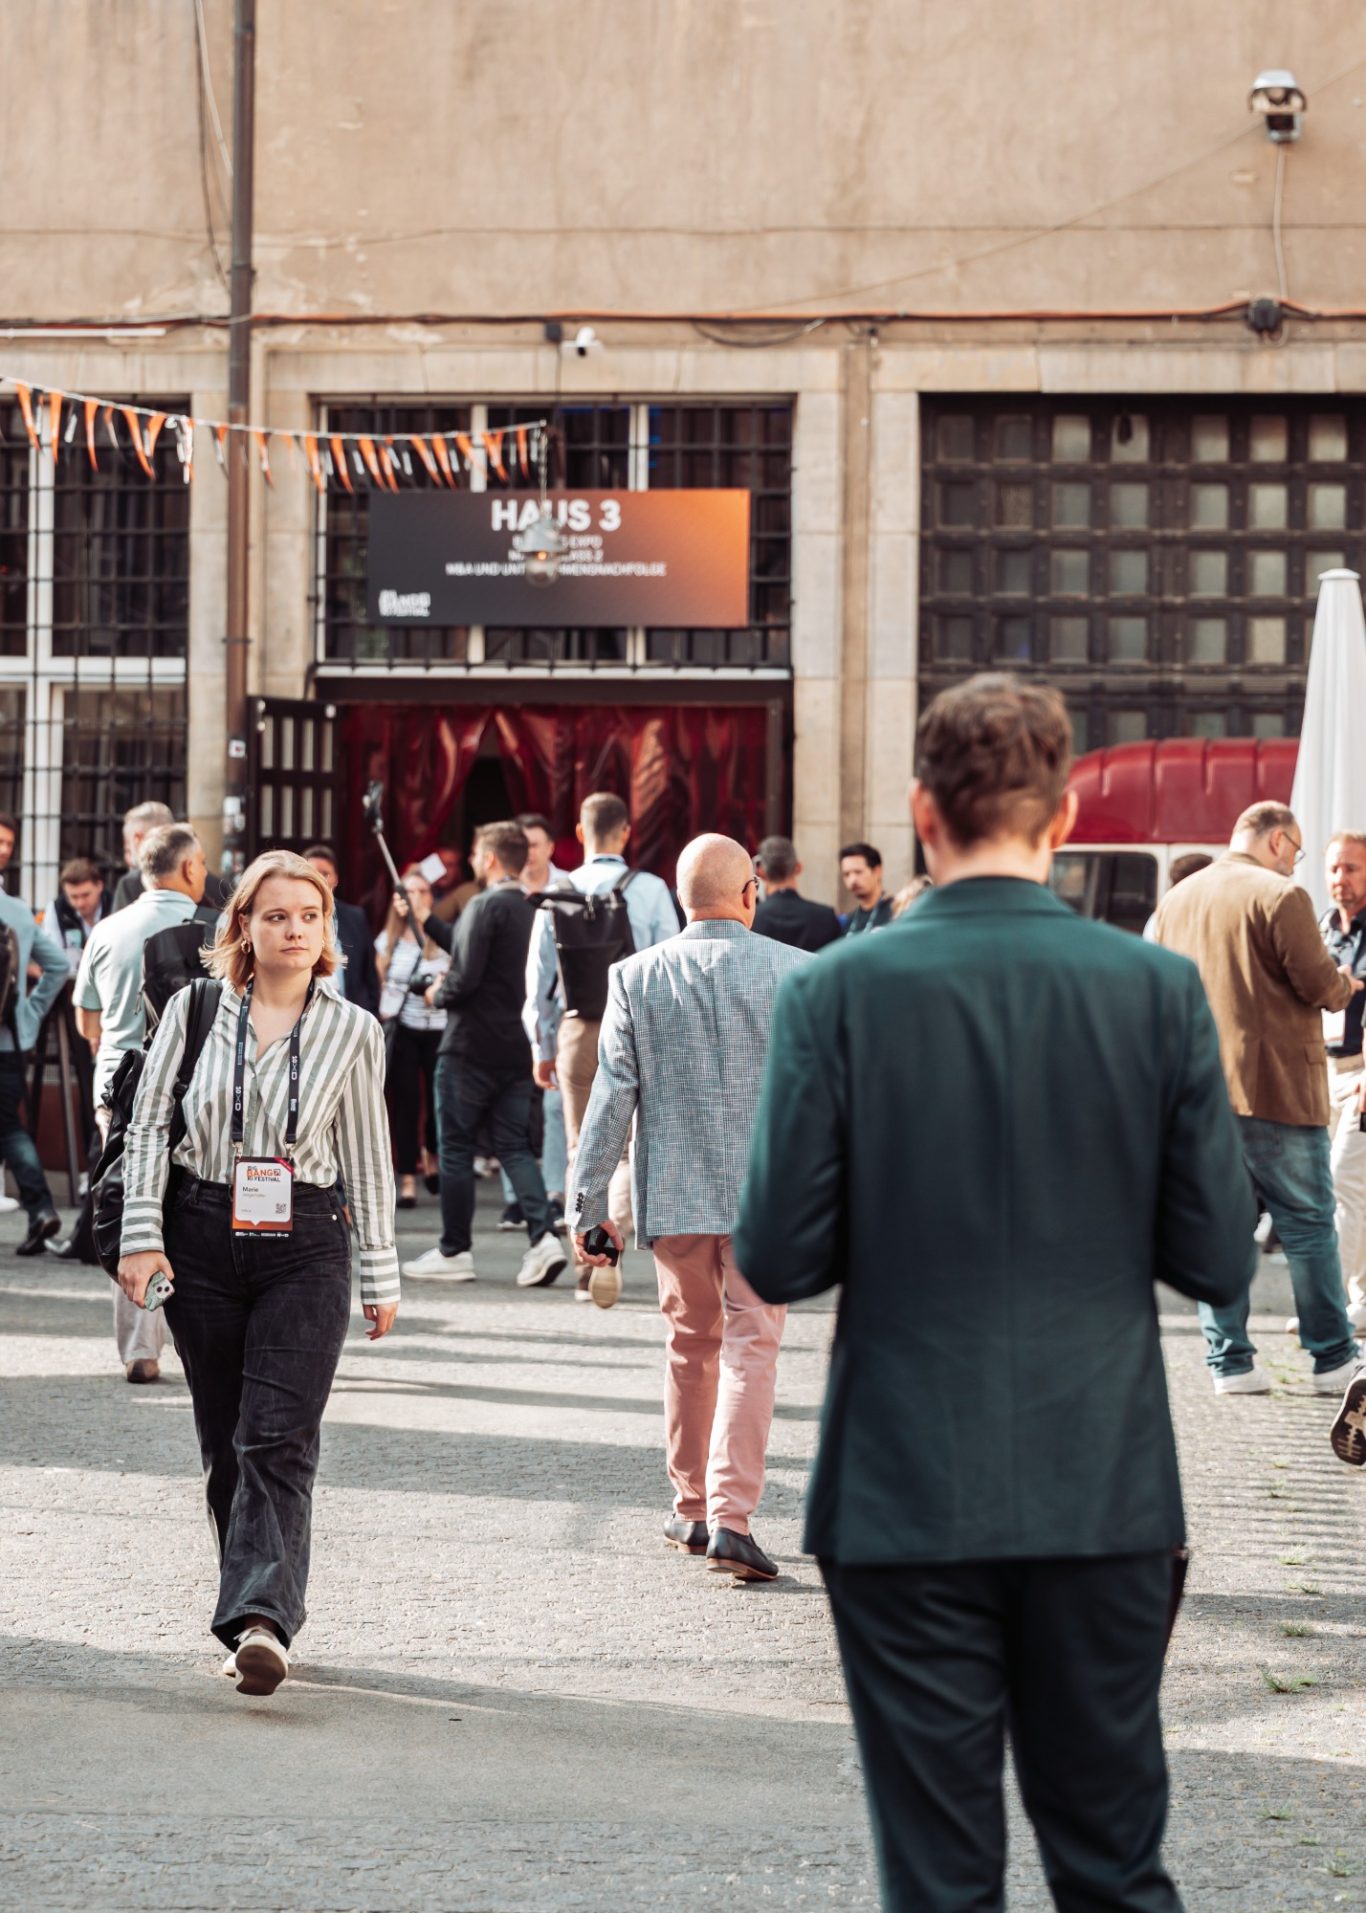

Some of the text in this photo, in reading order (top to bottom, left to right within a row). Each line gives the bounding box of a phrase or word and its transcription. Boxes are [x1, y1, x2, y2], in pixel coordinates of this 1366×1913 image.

[490, 498, 622, 533] HAUS 3
[247, 1169, 273, 1177] BANG
